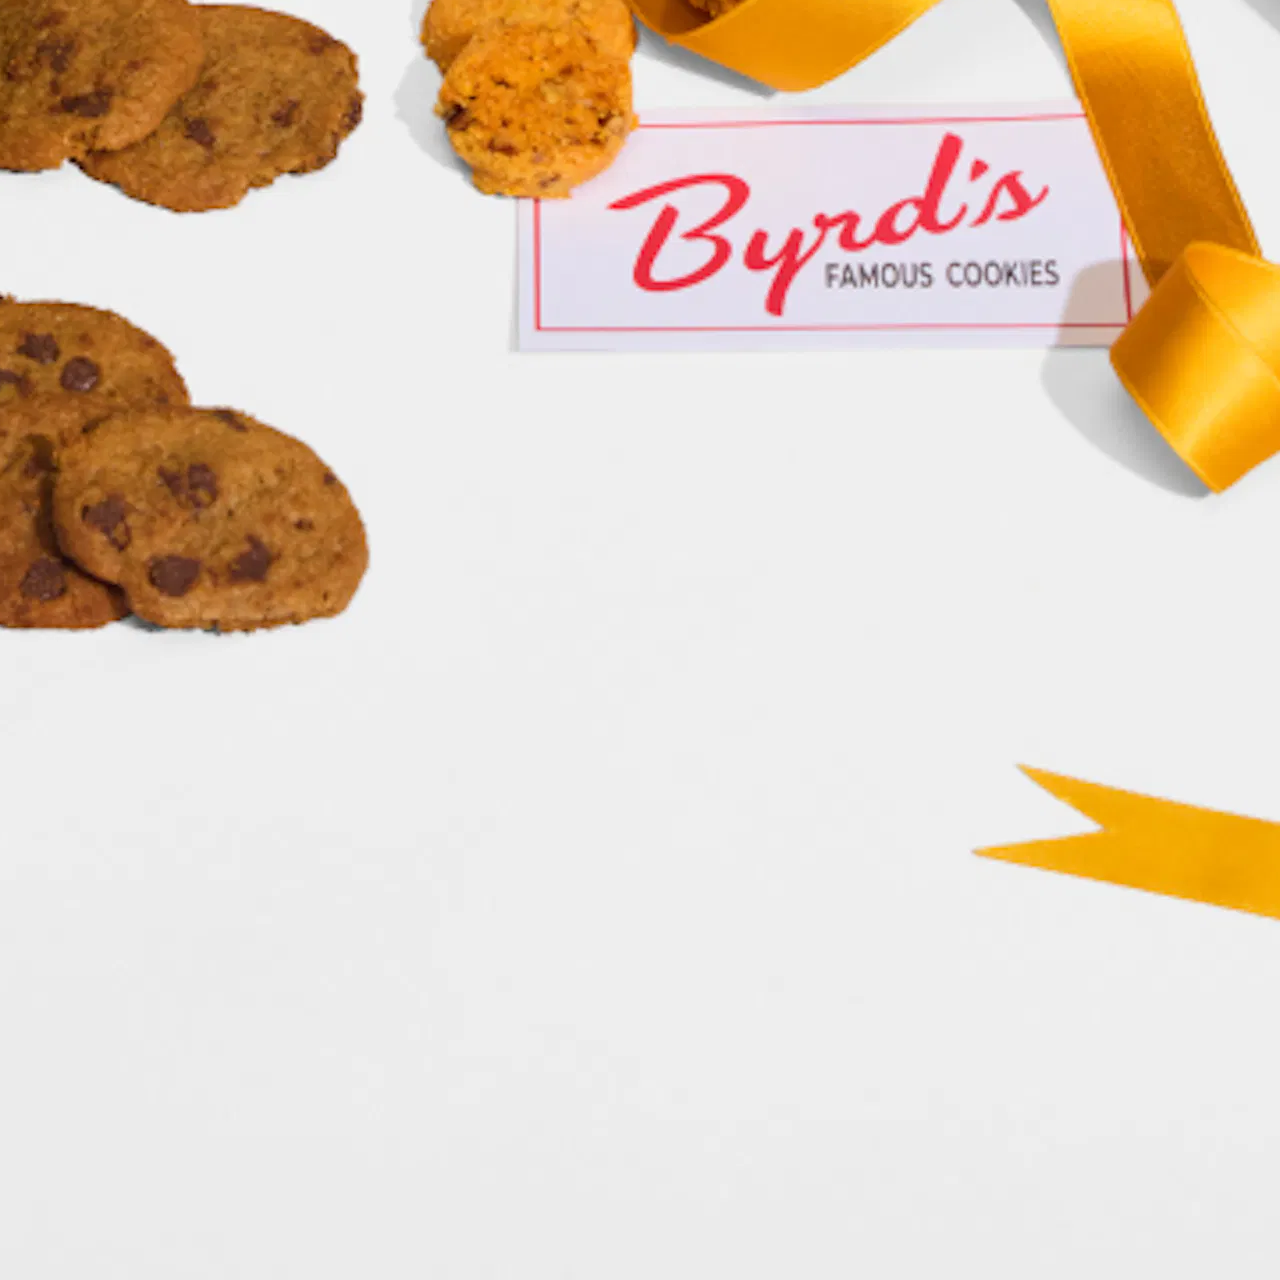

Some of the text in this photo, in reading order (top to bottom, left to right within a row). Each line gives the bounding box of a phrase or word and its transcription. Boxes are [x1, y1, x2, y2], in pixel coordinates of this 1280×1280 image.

[605, 131, 1050, 318] Byrd's
[823, 259, 1060, 290] FAMOUS COOKIES
